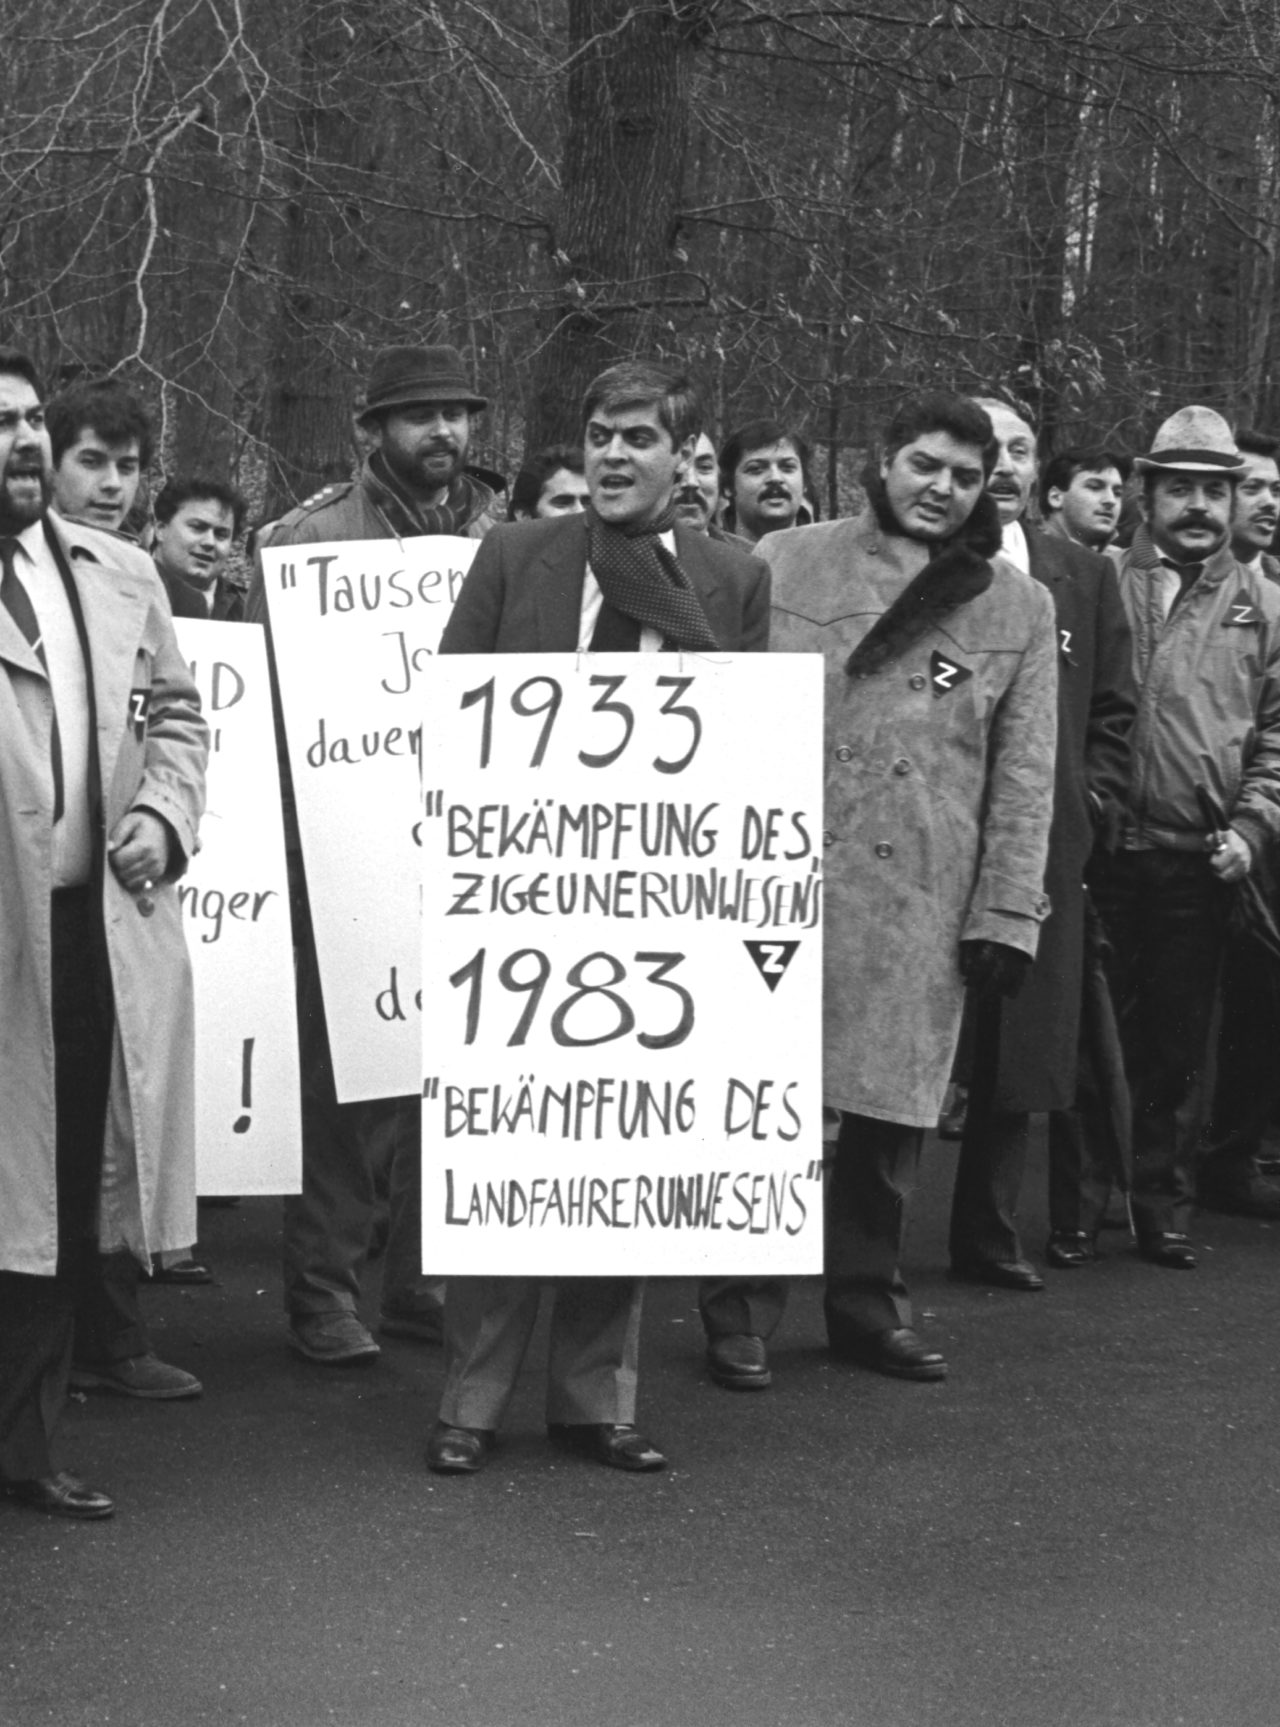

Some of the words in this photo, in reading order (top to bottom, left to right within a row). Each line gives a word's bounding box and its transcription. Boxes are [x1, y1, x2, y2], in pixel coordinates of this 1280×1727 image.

[1231, 604, 1255, 624] Z
[131, 694, 146, 722] Z
[933, 659, 958, 689] Z
[459, 674, 703, 775] 1933
[425, 789, 721, 861] "BEKÄMPFUNG
[740, 804, 812, 861] DES
[759, 945, 785, 974] Z
[448, 947, 696, 1051] 1983
[232, 1037, 255, 1134] !
[423, 1073, 696, 1142] "BEKÄMPFUNG
[723, 1077, 802, 1142] DES
[444, 1159, 823, 1237] LANDFAHRERUNWESENS"
